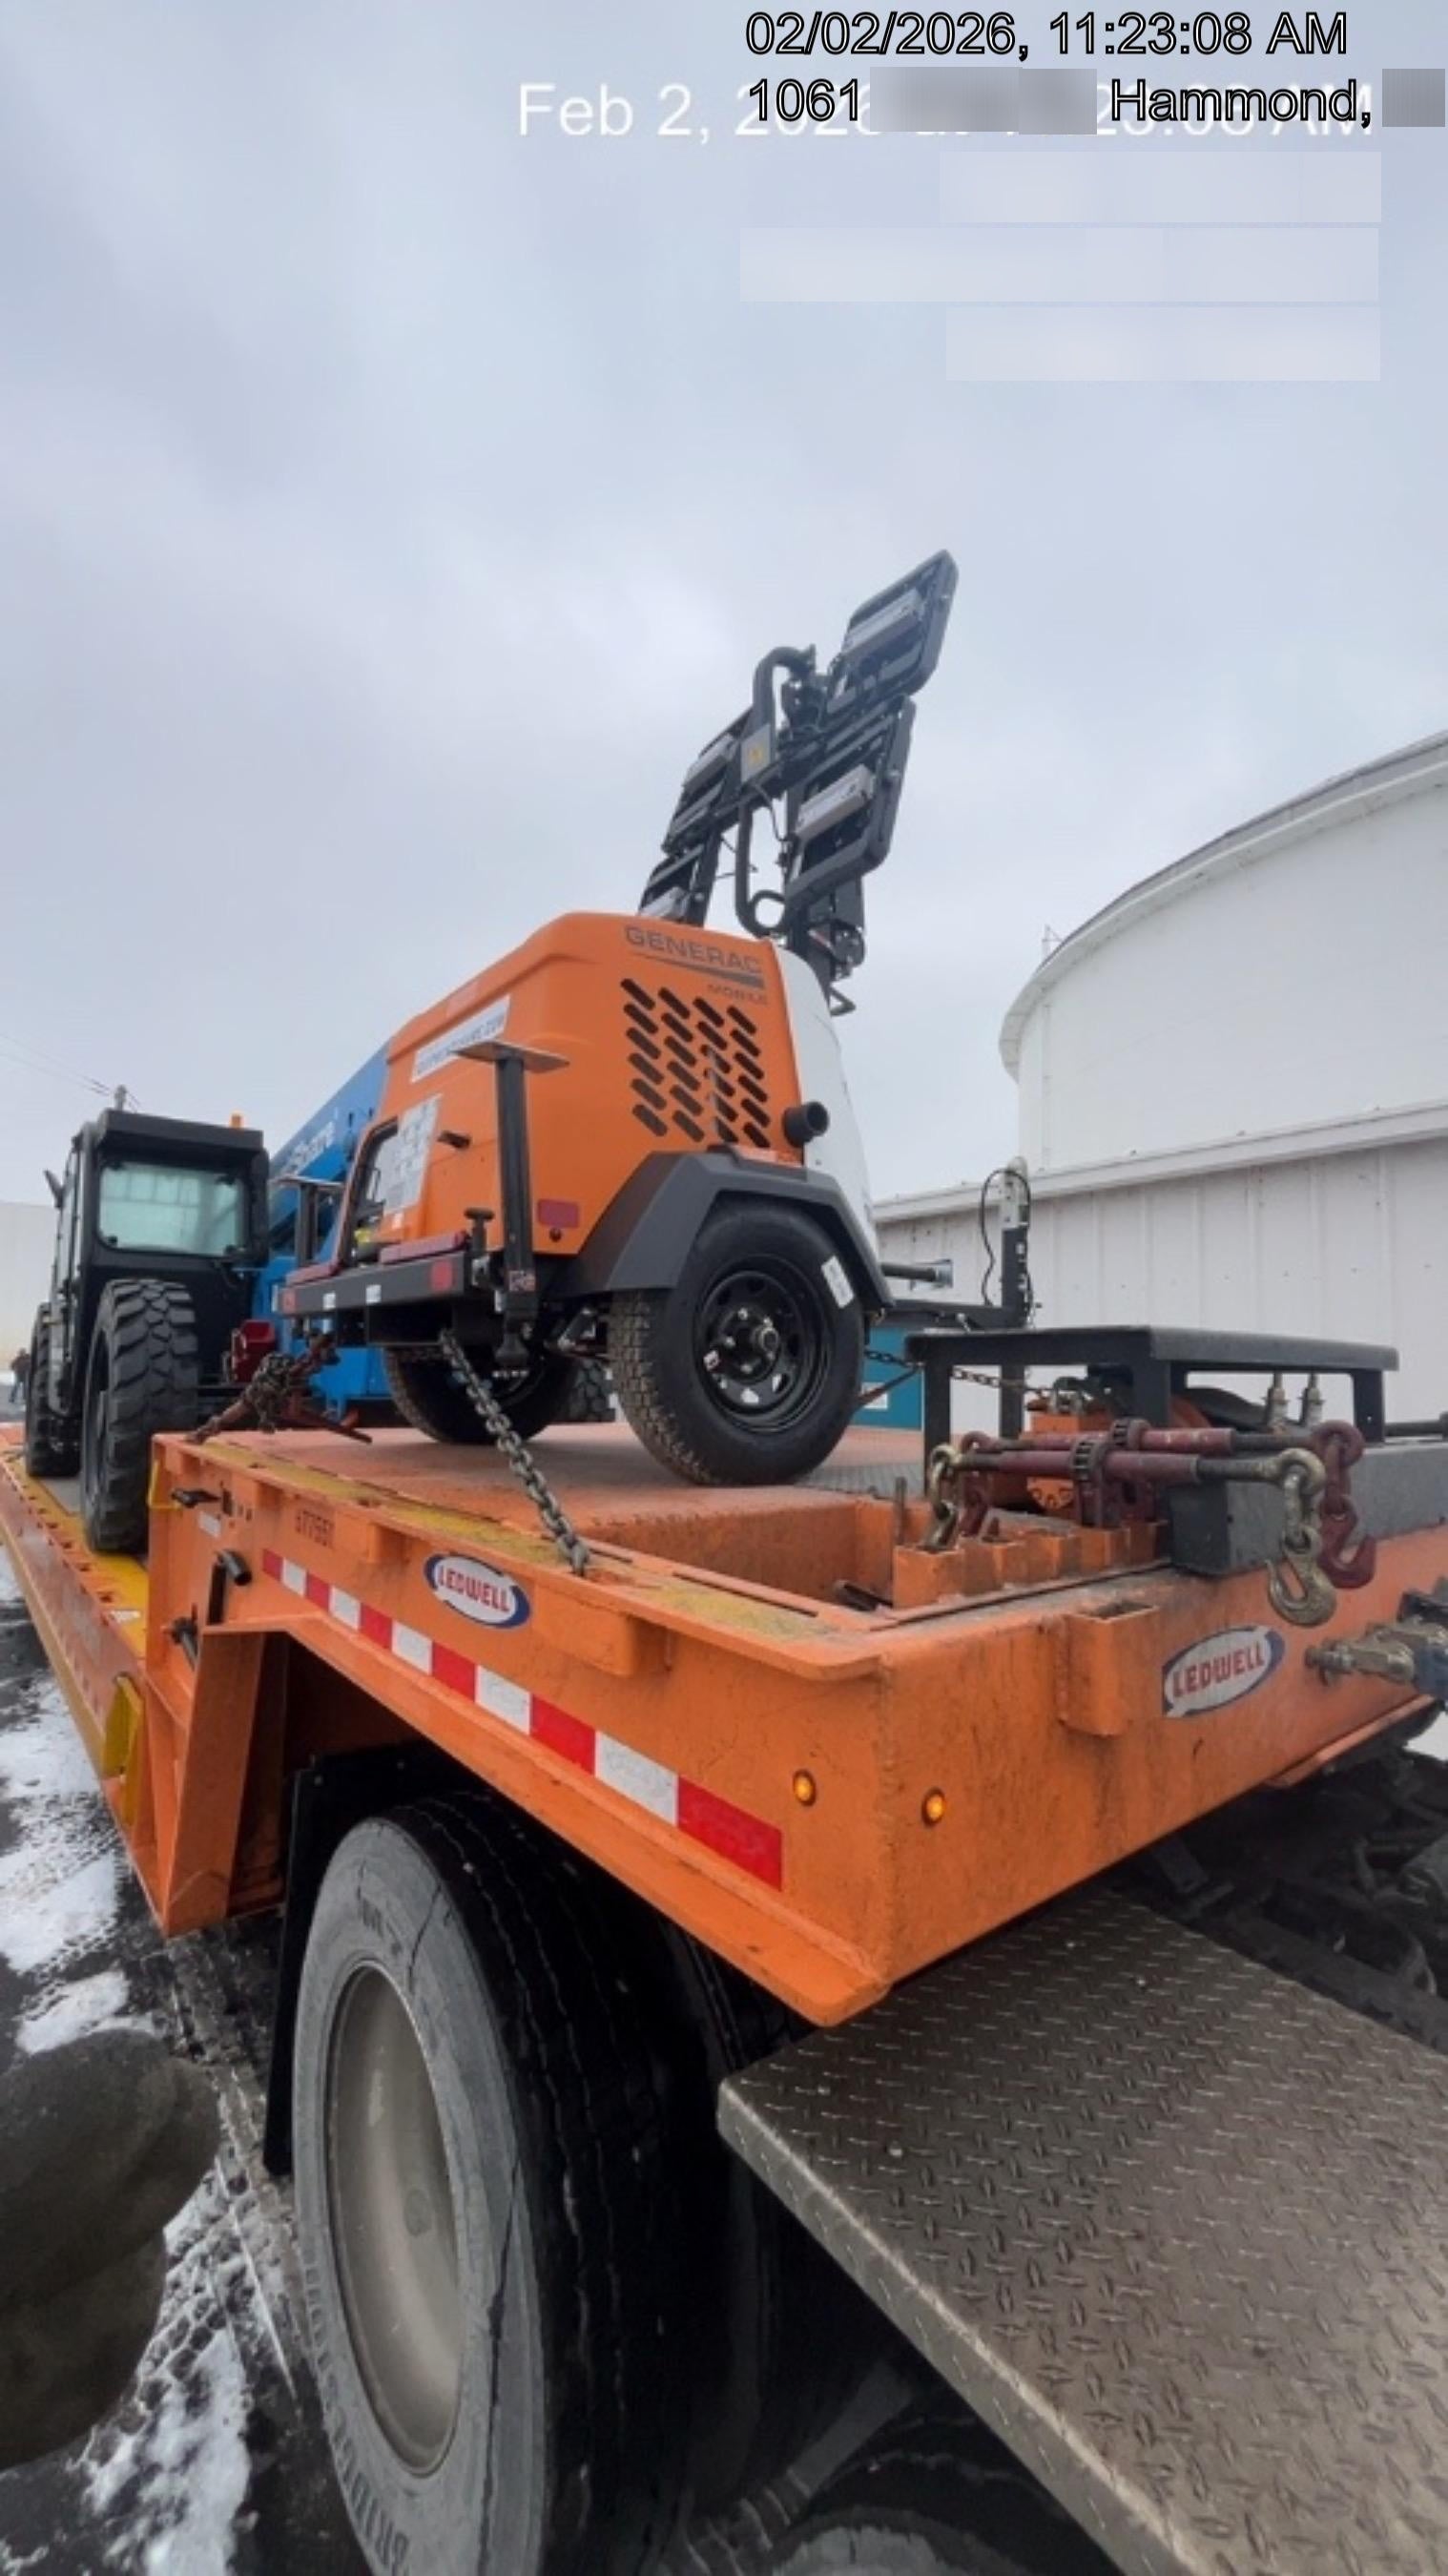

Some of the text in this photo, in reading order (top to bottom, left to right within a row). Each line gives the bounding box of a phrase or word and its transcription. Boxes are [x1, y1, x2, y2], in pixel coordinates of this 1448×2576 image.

[626, 925, 762, 974] GENERAC
[438, 1564, 510, 1614] LEDWELL
[1172, 1639, 1265, 1698] LEDWELL
